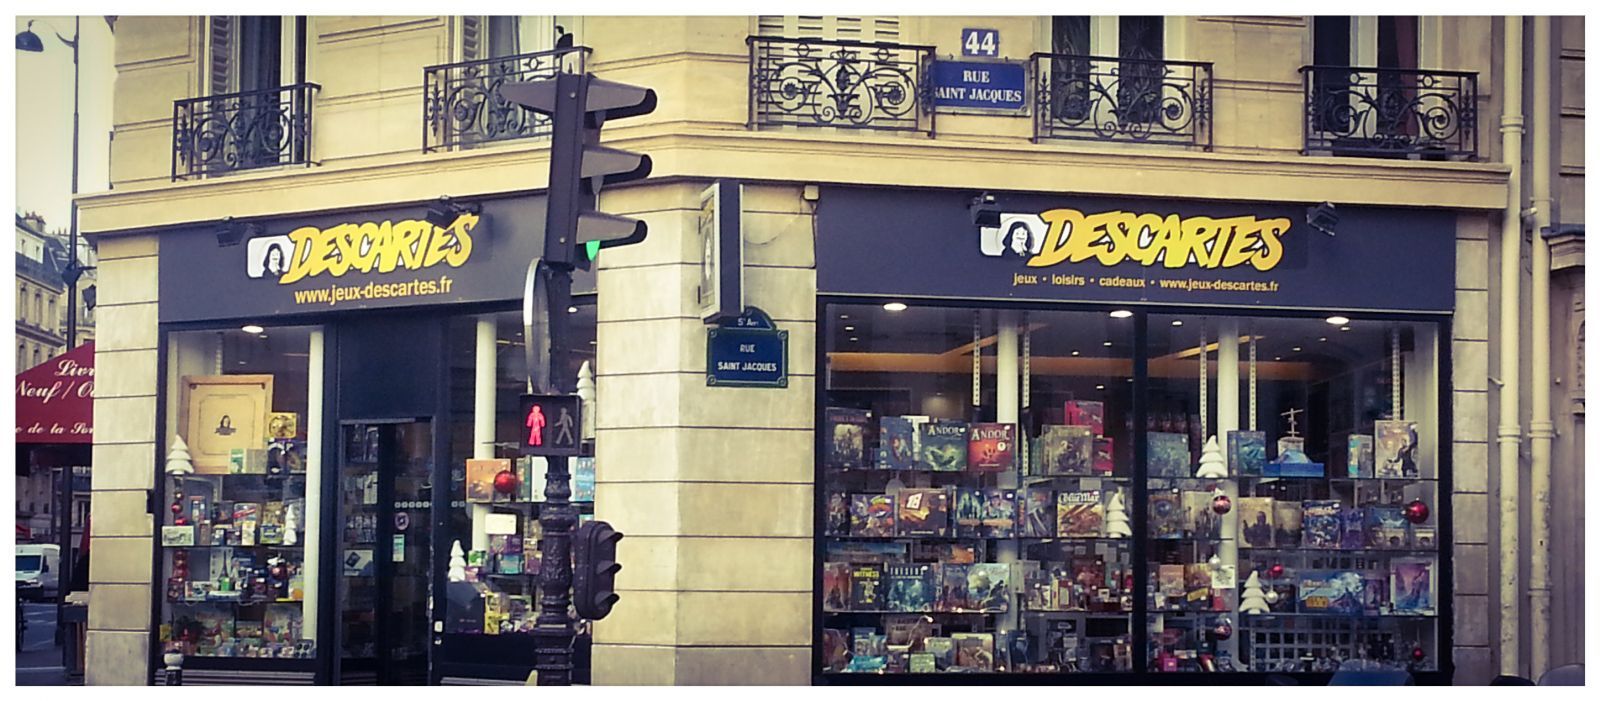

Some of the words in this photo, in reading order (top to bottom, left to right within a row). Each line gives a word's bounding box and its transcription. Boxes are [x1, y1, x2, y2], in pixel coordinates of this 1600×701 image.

[965, 31, 996, 55] 44
[963, 70, 990, 83] RUE
[969, 88, 1022, 103] JACQUES
[1026, 208, 1292, 271] DESCARTES
[279, 213, 480, 284] DESCARTES
[294, 275, 453, 305] www.jeux-descartes.fr
[1012, 273, 1037, 286] jeux
[1051, 274, 1085, 286] loisirs
[1099, 275, 1146, 288] cadeaux
[1160, 278, 1279, 292] www.jeux-descartes.fr
[740, 344, 755, 353] RUE
[718, 362, 740, 371] SAINT
[742, 363, 777, 372] JACQUES
[27, 422, 43, 434] de
[50, 422, 65, 434] la
